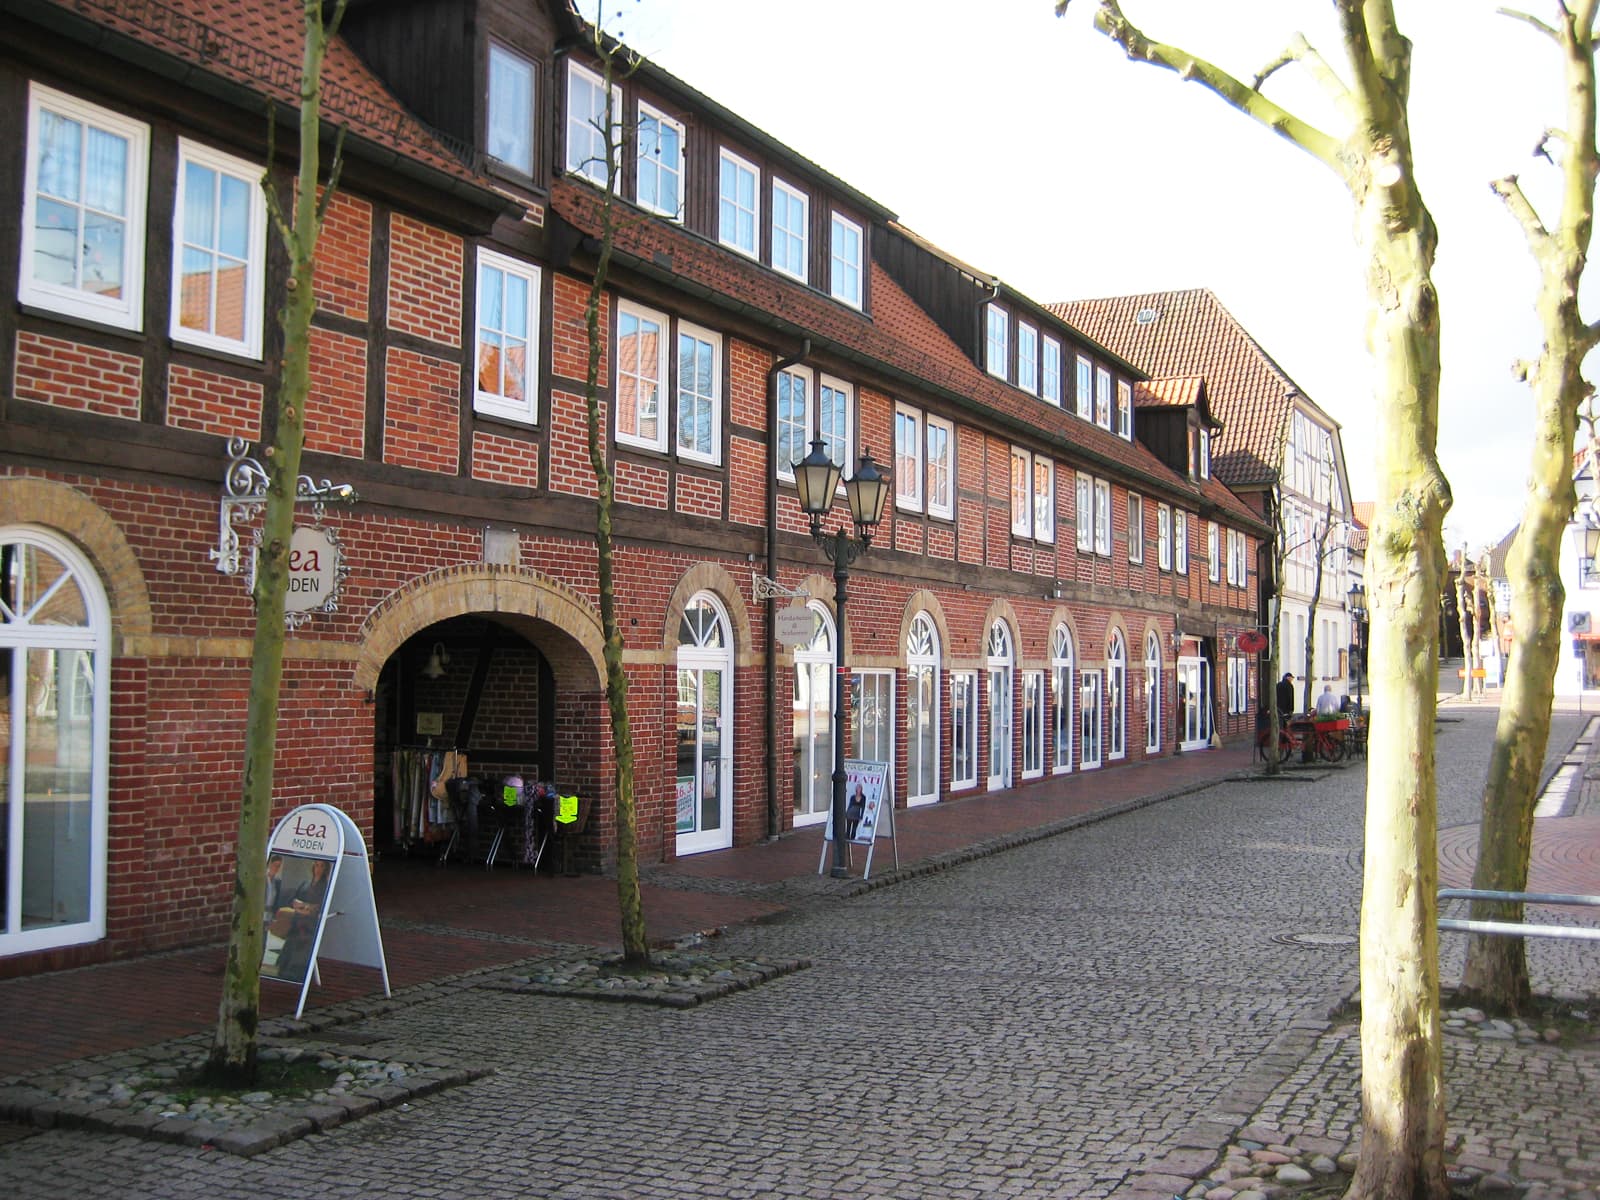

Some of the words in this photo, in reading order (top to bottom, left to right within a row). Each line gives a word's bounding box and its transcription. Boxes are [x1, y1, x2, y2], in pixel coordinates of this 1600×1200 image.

[288, 549, 321, 572] ea
[286, 577, 319, 592] DEN
[293, 816, 328, 839] Lea
[291, 838, 325, 851] MODEN
